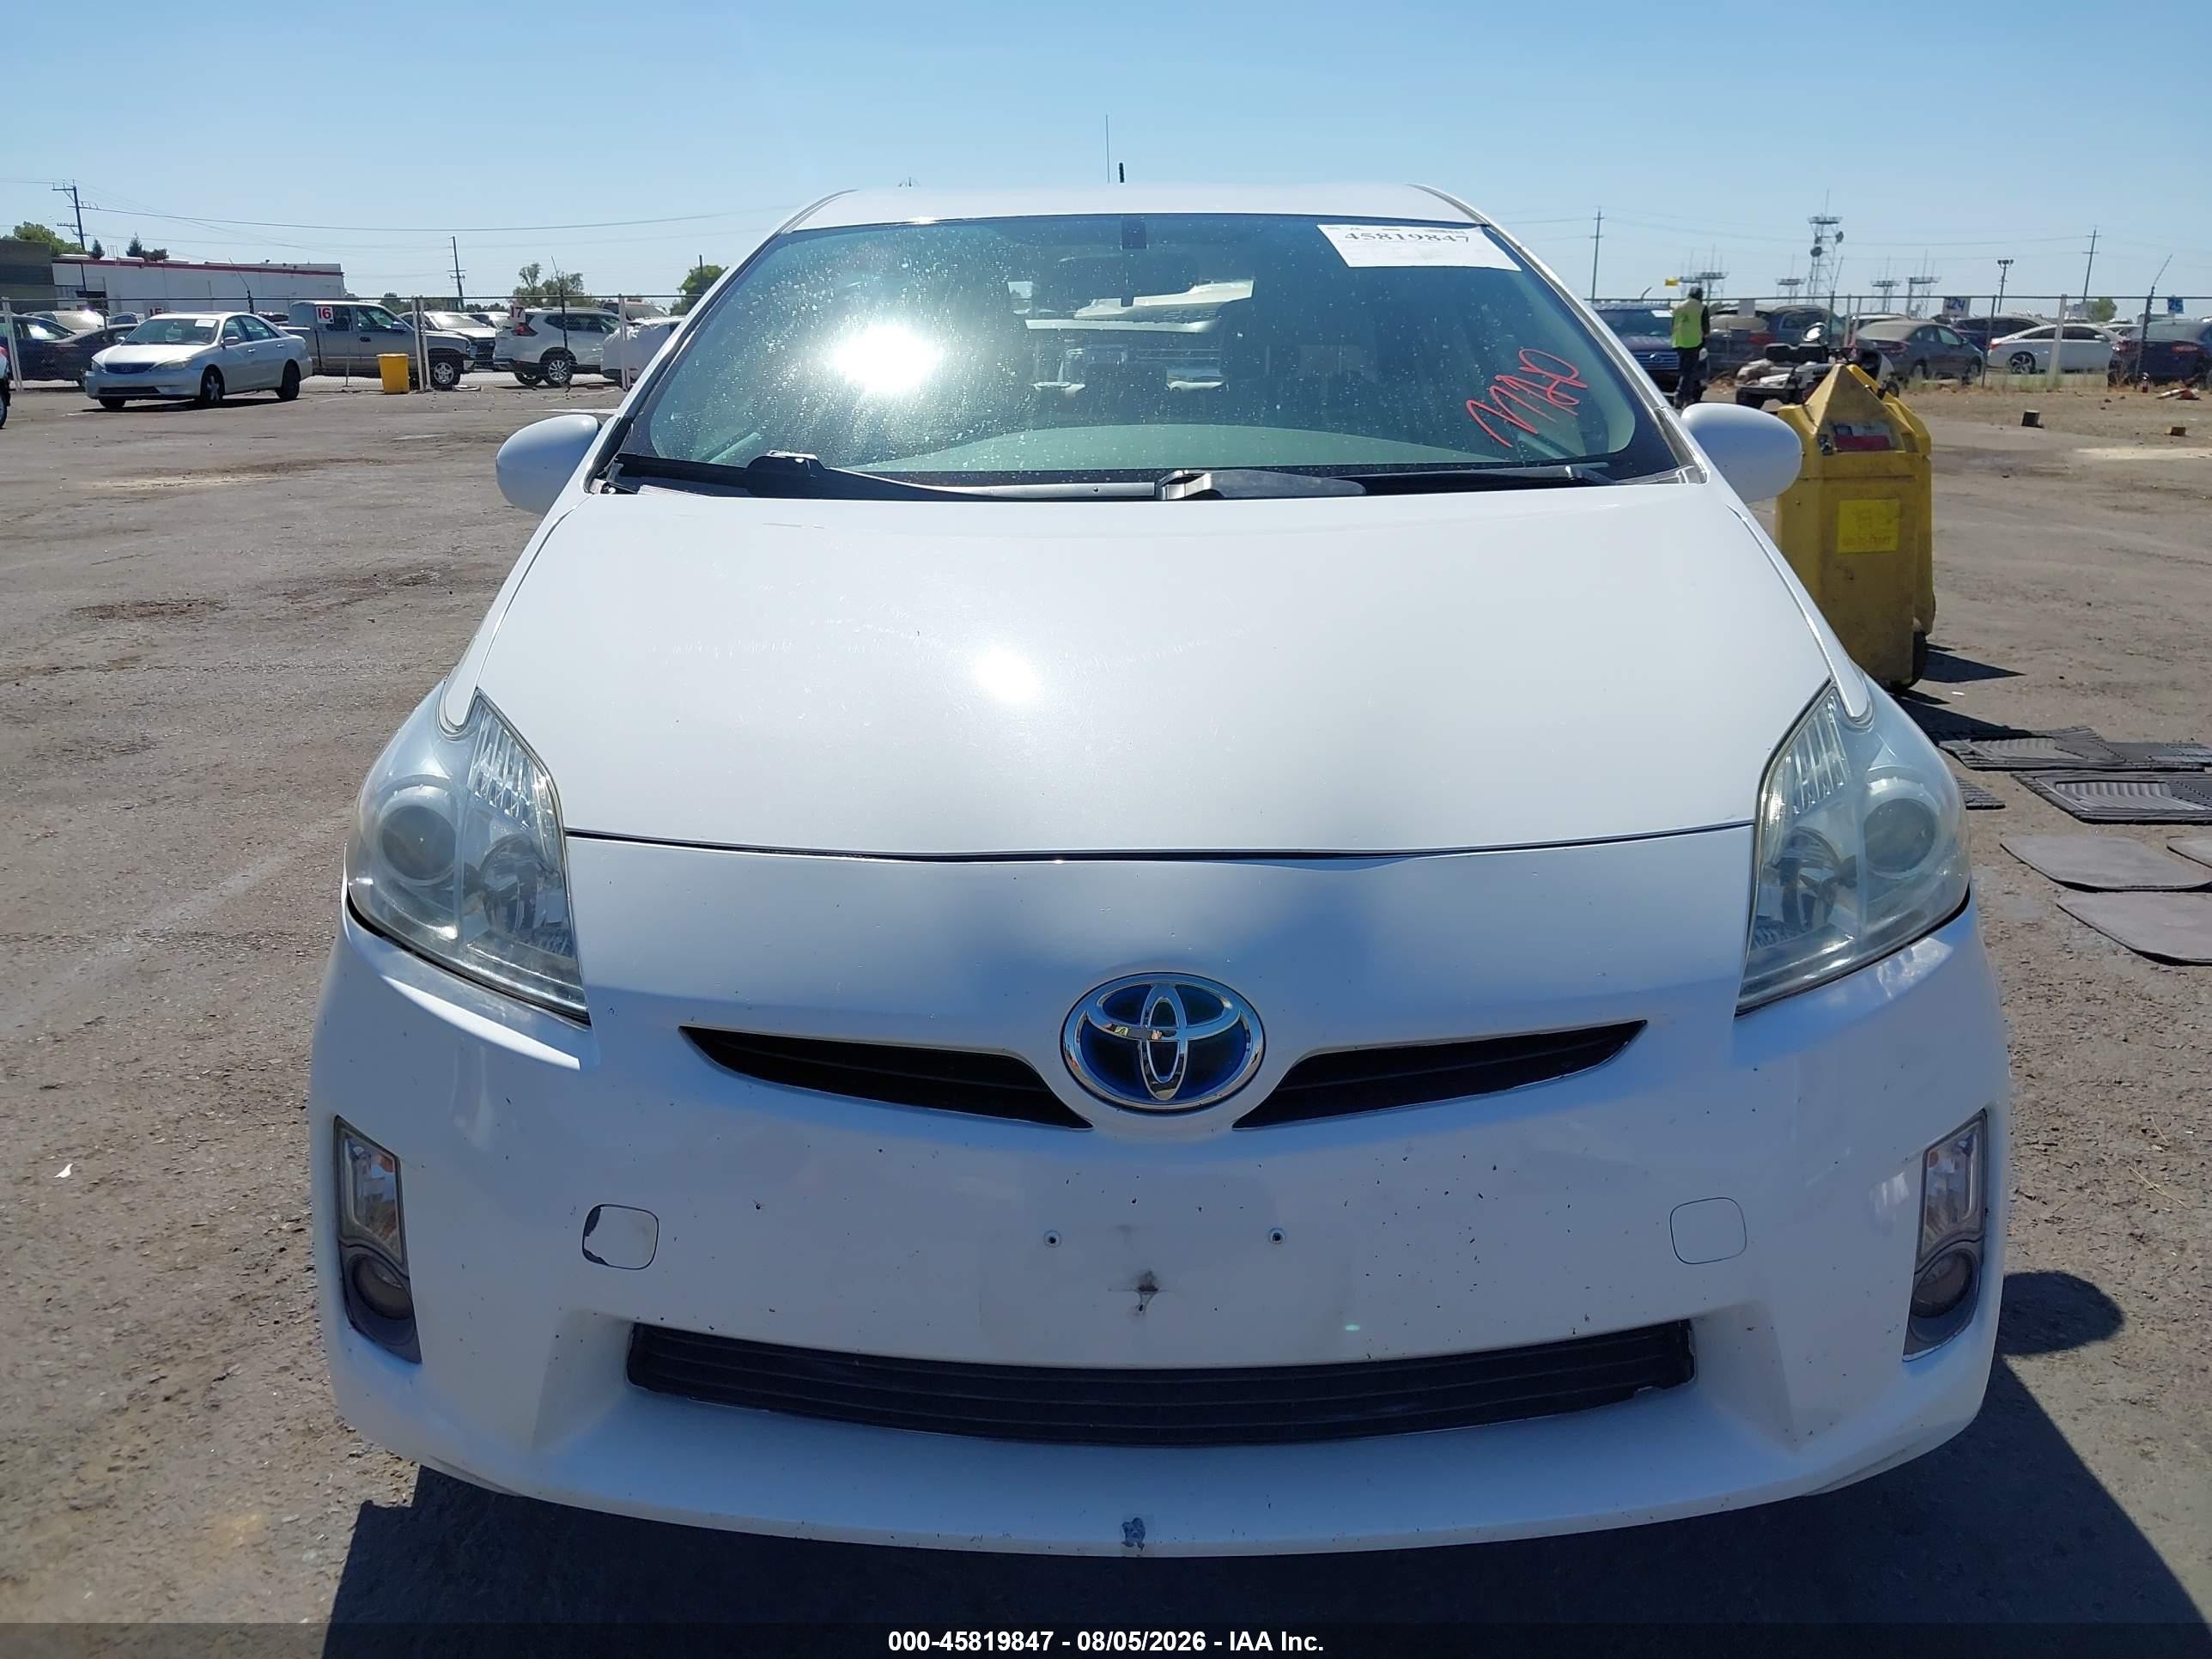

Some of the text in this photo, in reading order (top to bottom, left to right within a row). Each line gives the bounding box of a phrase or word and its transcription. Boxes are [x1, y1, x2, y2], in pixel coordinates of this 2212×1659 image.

[1345, 232, 1471, 243] 45819847
[318, 307, 331, 319] 16
[511, 307, 524, 318] 17
